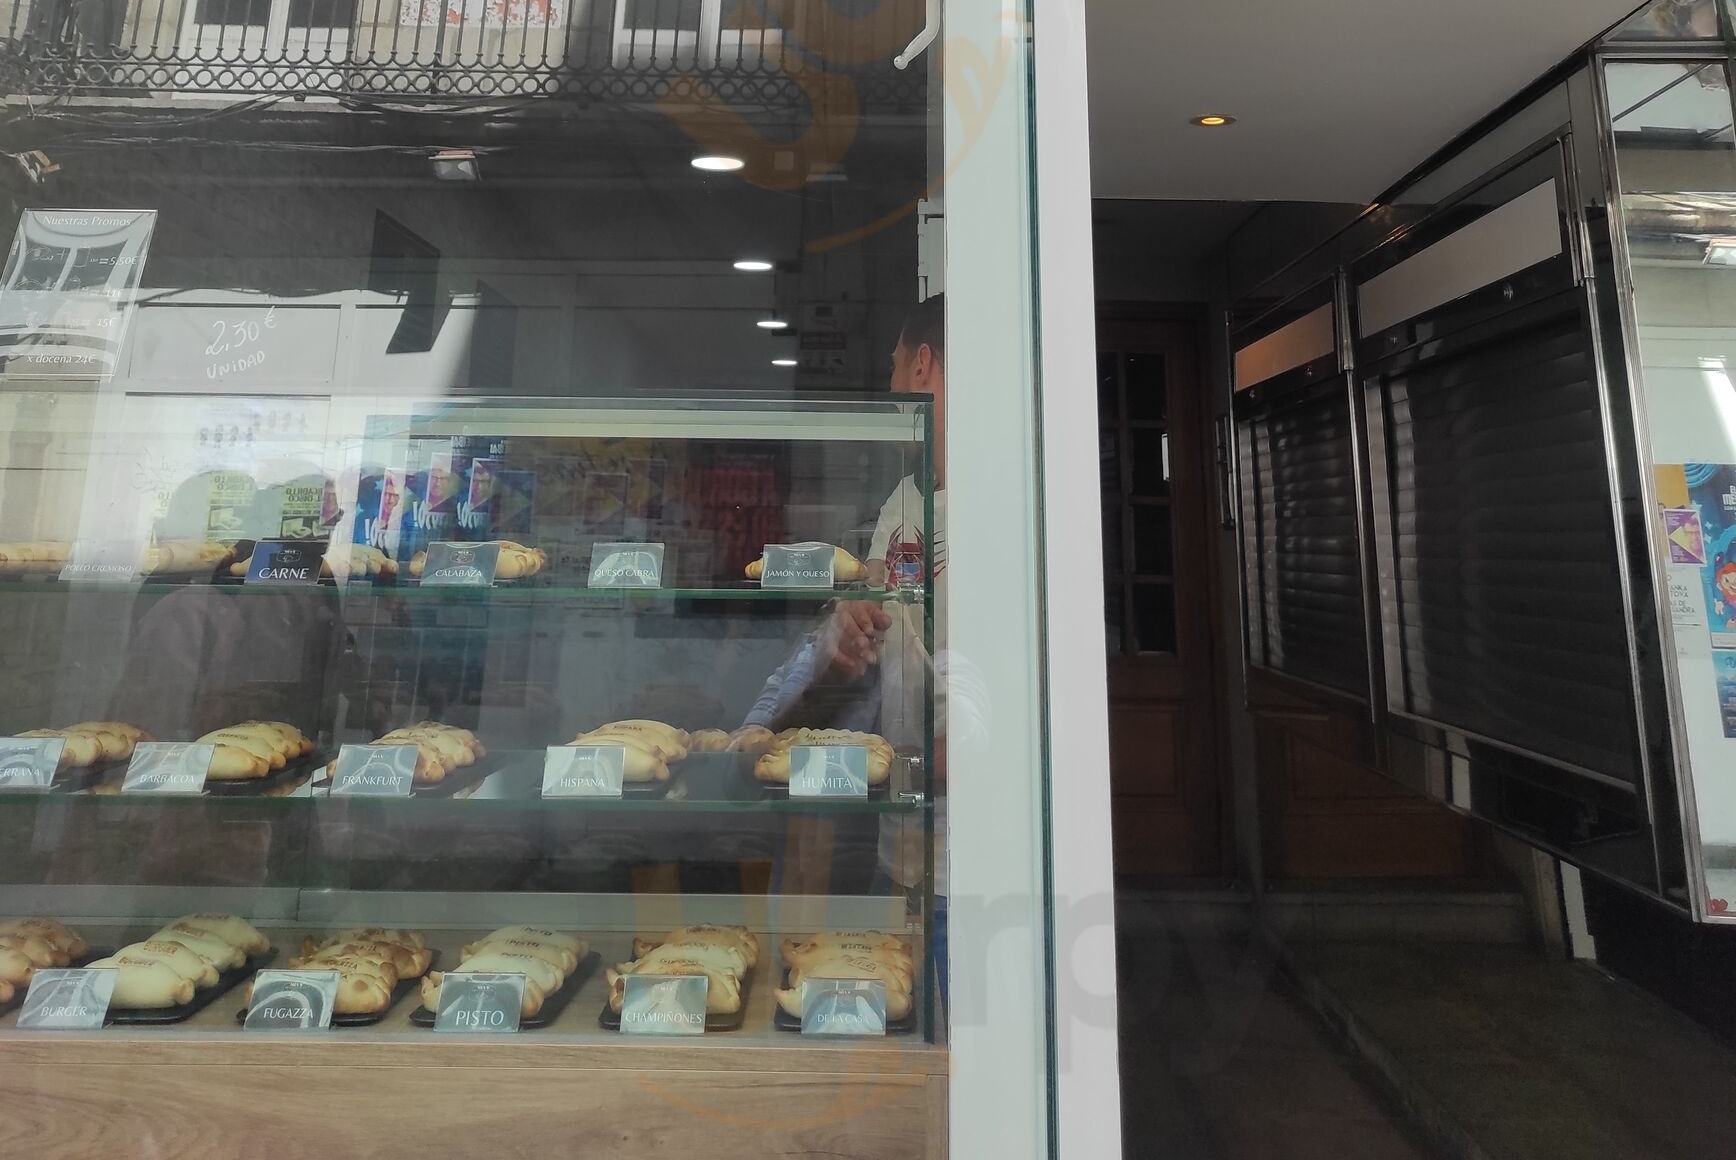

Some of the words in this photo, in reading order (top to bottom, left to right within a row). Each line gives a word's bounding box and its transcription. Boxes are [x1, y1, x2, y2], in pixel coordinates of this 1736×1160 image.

[42, 215, 89, 226] Nuestras
[91, 216, 131, 227] Promos
[36, 353, 72, 364] docena
[259, 567, 310, 580] CARNE
[435, 569, 482, 578] CALABAZA
[594, 569, 624, 578] QUESO
[625, 569, 655, 578] CABRA
[766, 568, 795, 578] JAMÓN
[802, 570, 830, 578] QUESO
[139, 774, 195, 785] BARBACOA
[342, 775, 403, 786] FRANKFURT
[560, 777, 605, 788] HISPANA
[801, 777, 854, 789] HUMITA
[40, 1006, 88, 1018] BURGER
[263, 1007, 314, 1020] FUGAZZA
[455, 1009, 505, 1026] PISTO
[625, 1010, 703, 1025] CHAMPIÑONES
[817, 1014, 829, 1024] DE
